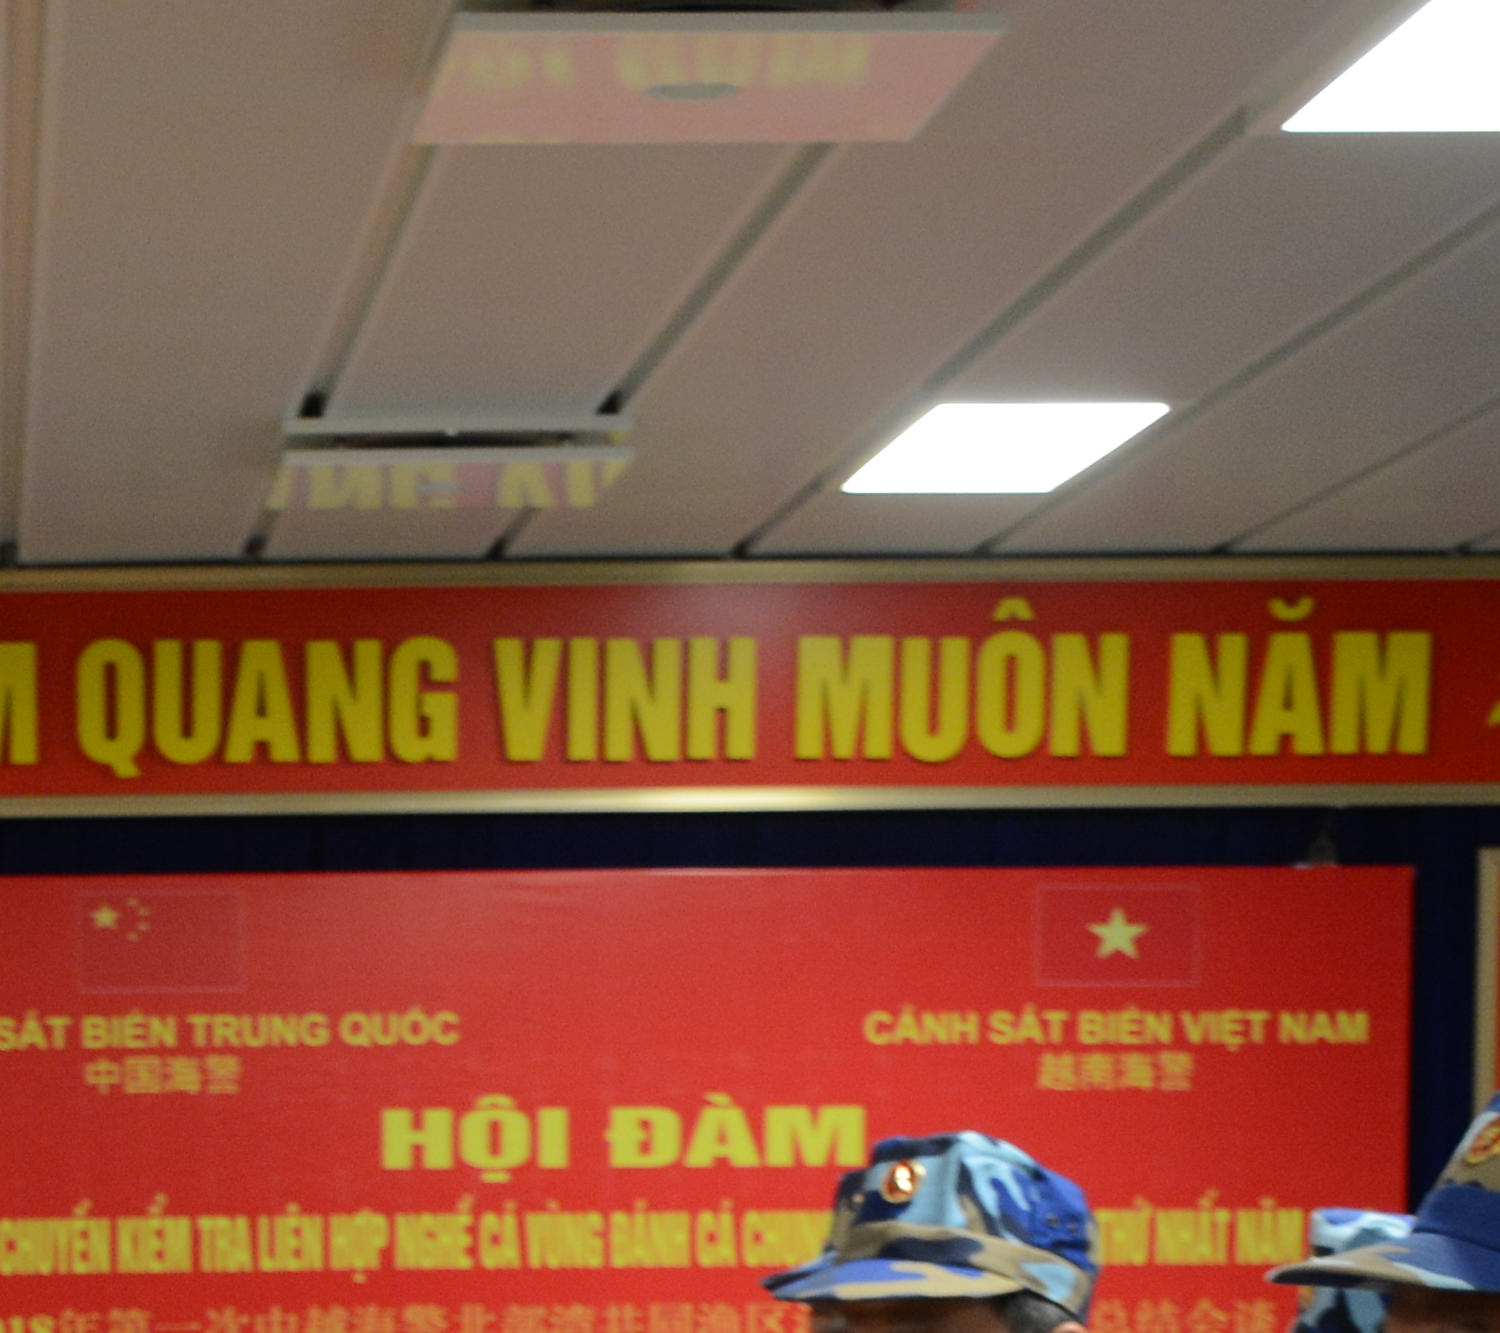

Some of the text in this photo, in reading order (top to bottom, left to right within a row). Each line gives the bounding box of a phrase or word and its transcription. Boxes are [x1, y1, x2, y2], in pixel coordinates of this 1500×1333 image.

[76, 635, 460, 779] QUANG
[492, 636, 758, 763] VINH
[794, 597, 1131, 763] MUÔN
[1166, 597, 1433, 757] NĂM
[186, 1012, 331, 1048] TRUNG
[338, 1004, 461, 1047] QUỐC
[1179, 1006, 1269, 1053] VIỆT
[1278, 1010, 1370, 1045] NAM
[380, 1091, 867, 1184] HỘI ĐÀM
[197, 1214, 254, 1273] TRA
